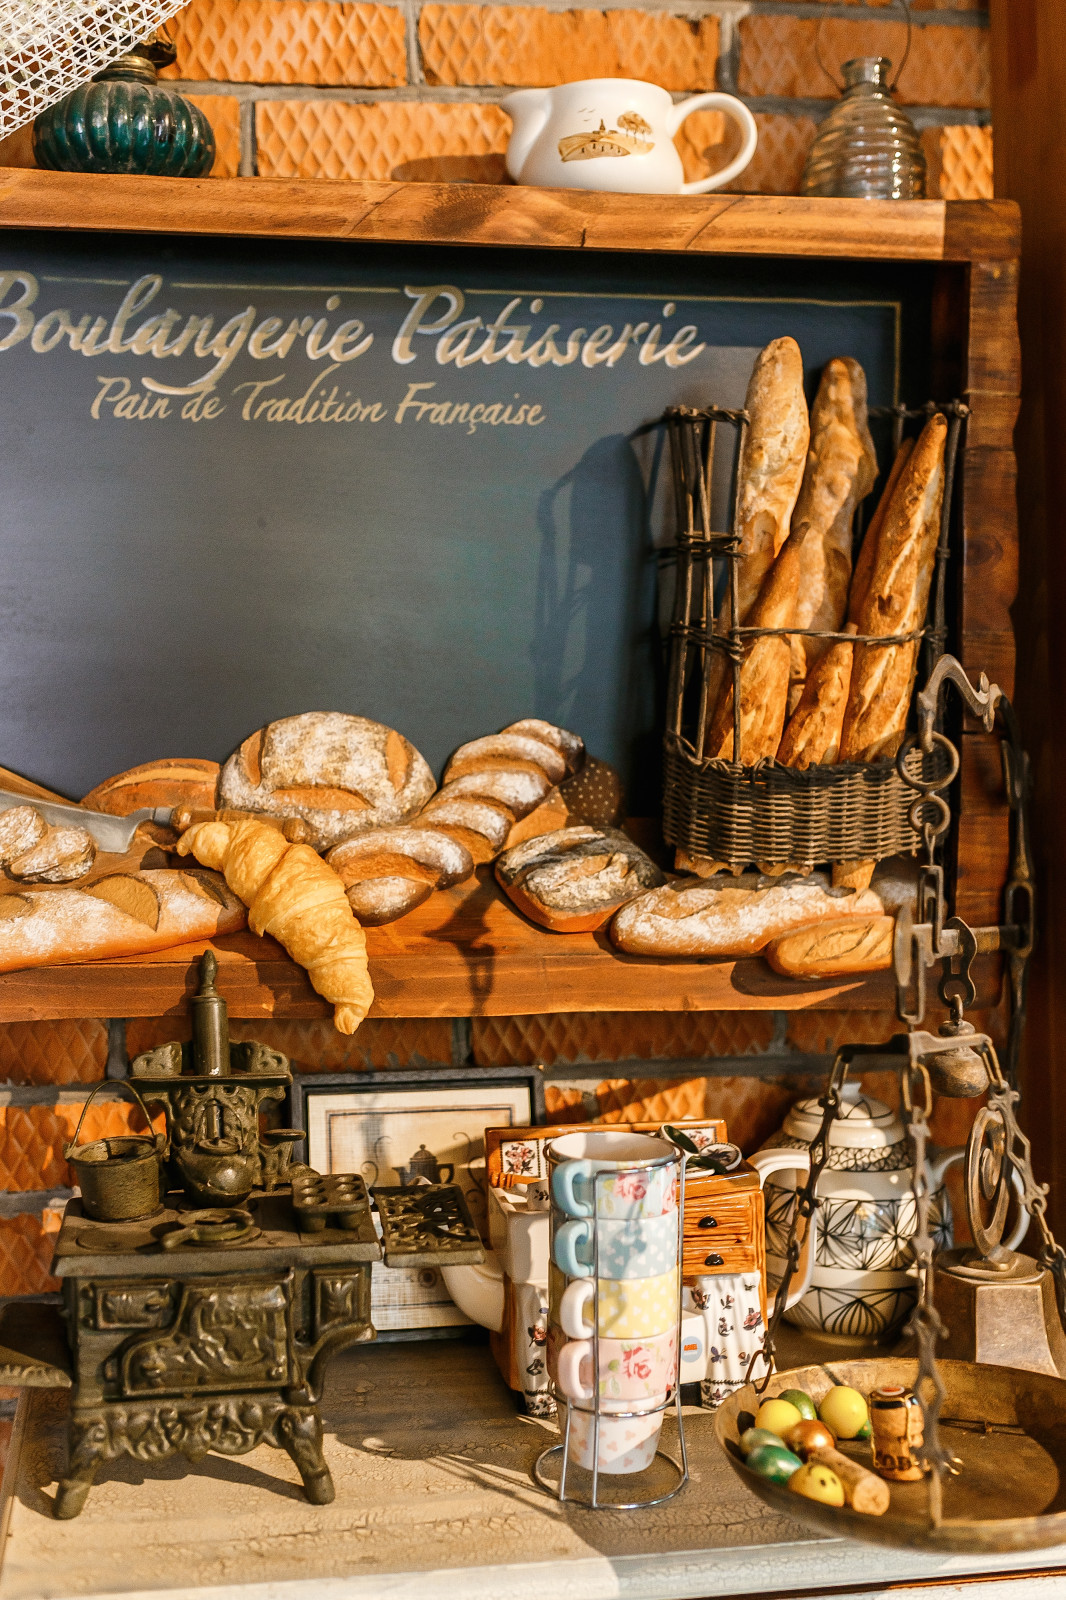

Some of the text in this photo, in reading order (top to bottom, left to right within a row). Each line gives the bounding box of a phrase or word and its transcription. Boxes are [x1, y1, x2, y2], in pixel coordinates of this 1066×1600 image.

[0, 270, 706, 395] Boulangerie Patisserie
[90, 363, 547, 436] Pain de Tradition Française
